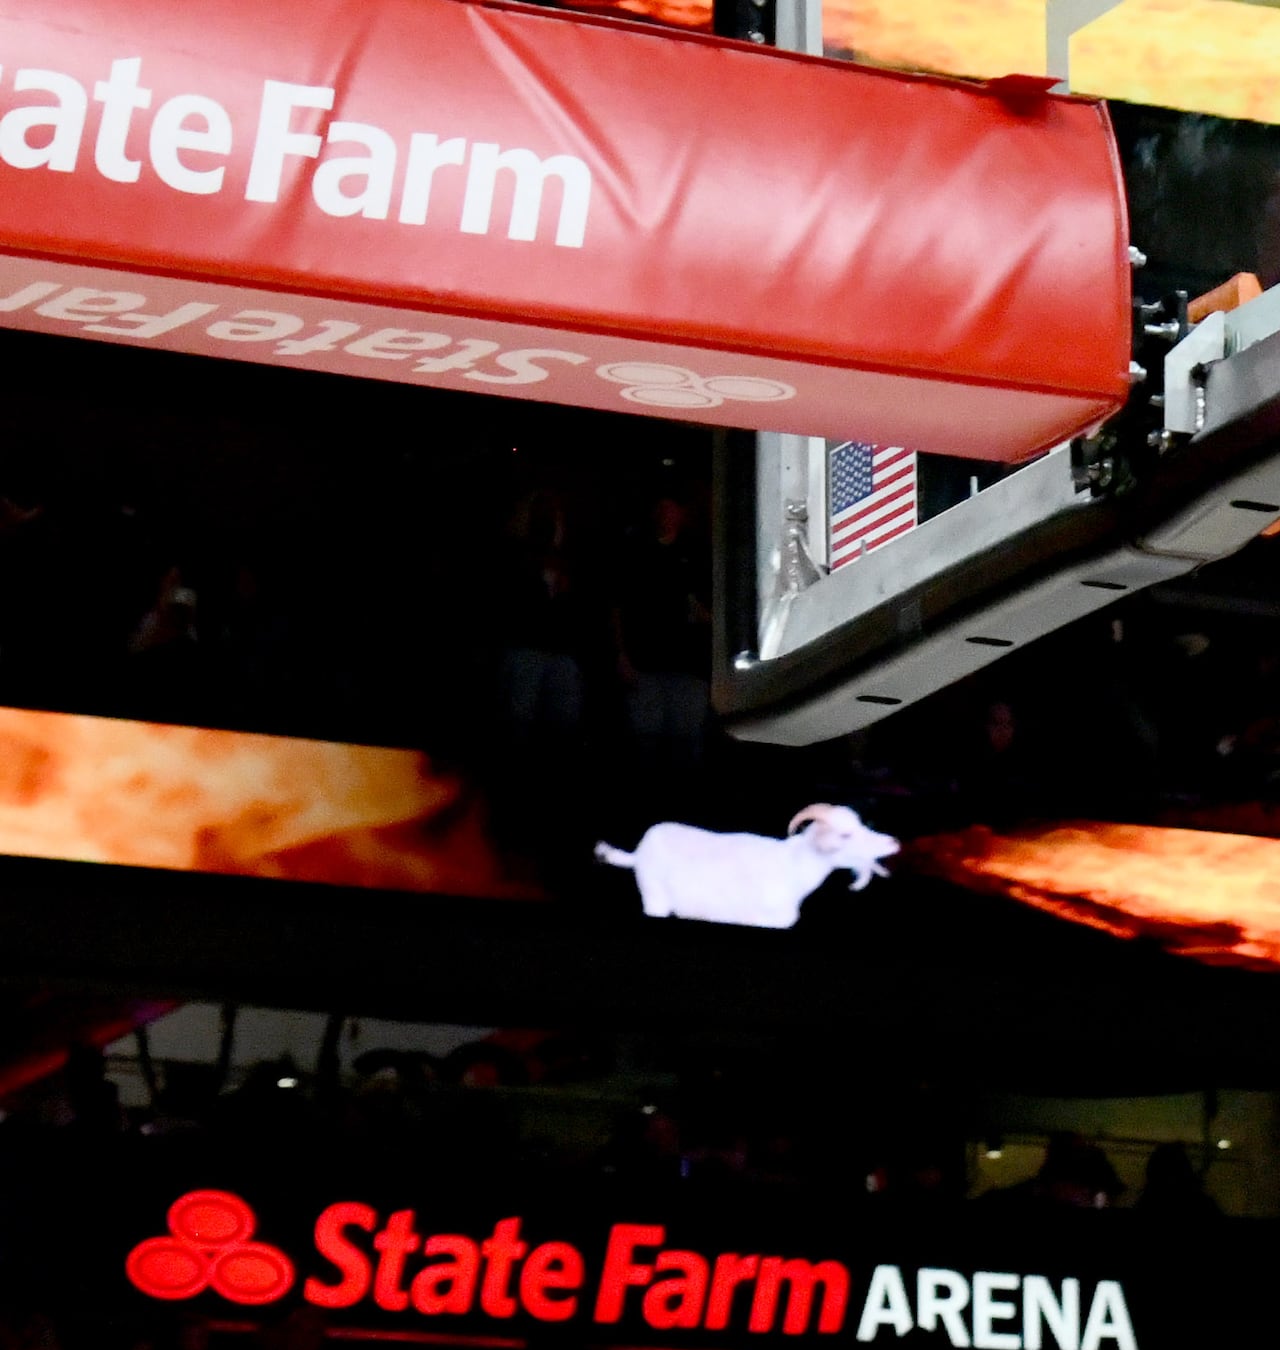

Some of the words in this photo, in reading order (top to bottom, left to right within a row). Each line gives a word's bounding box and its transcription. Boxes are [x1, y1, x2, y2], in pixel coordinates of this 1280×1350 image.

[0, 57, 233, 195] ate
[244, 80, 592, 249] Farm
[0, 281, 206, 338] Far
[207, 310, 590, 385] State
[303, 1201, 584, 1321] State
[594, 1223, 850, 1335] Farm
